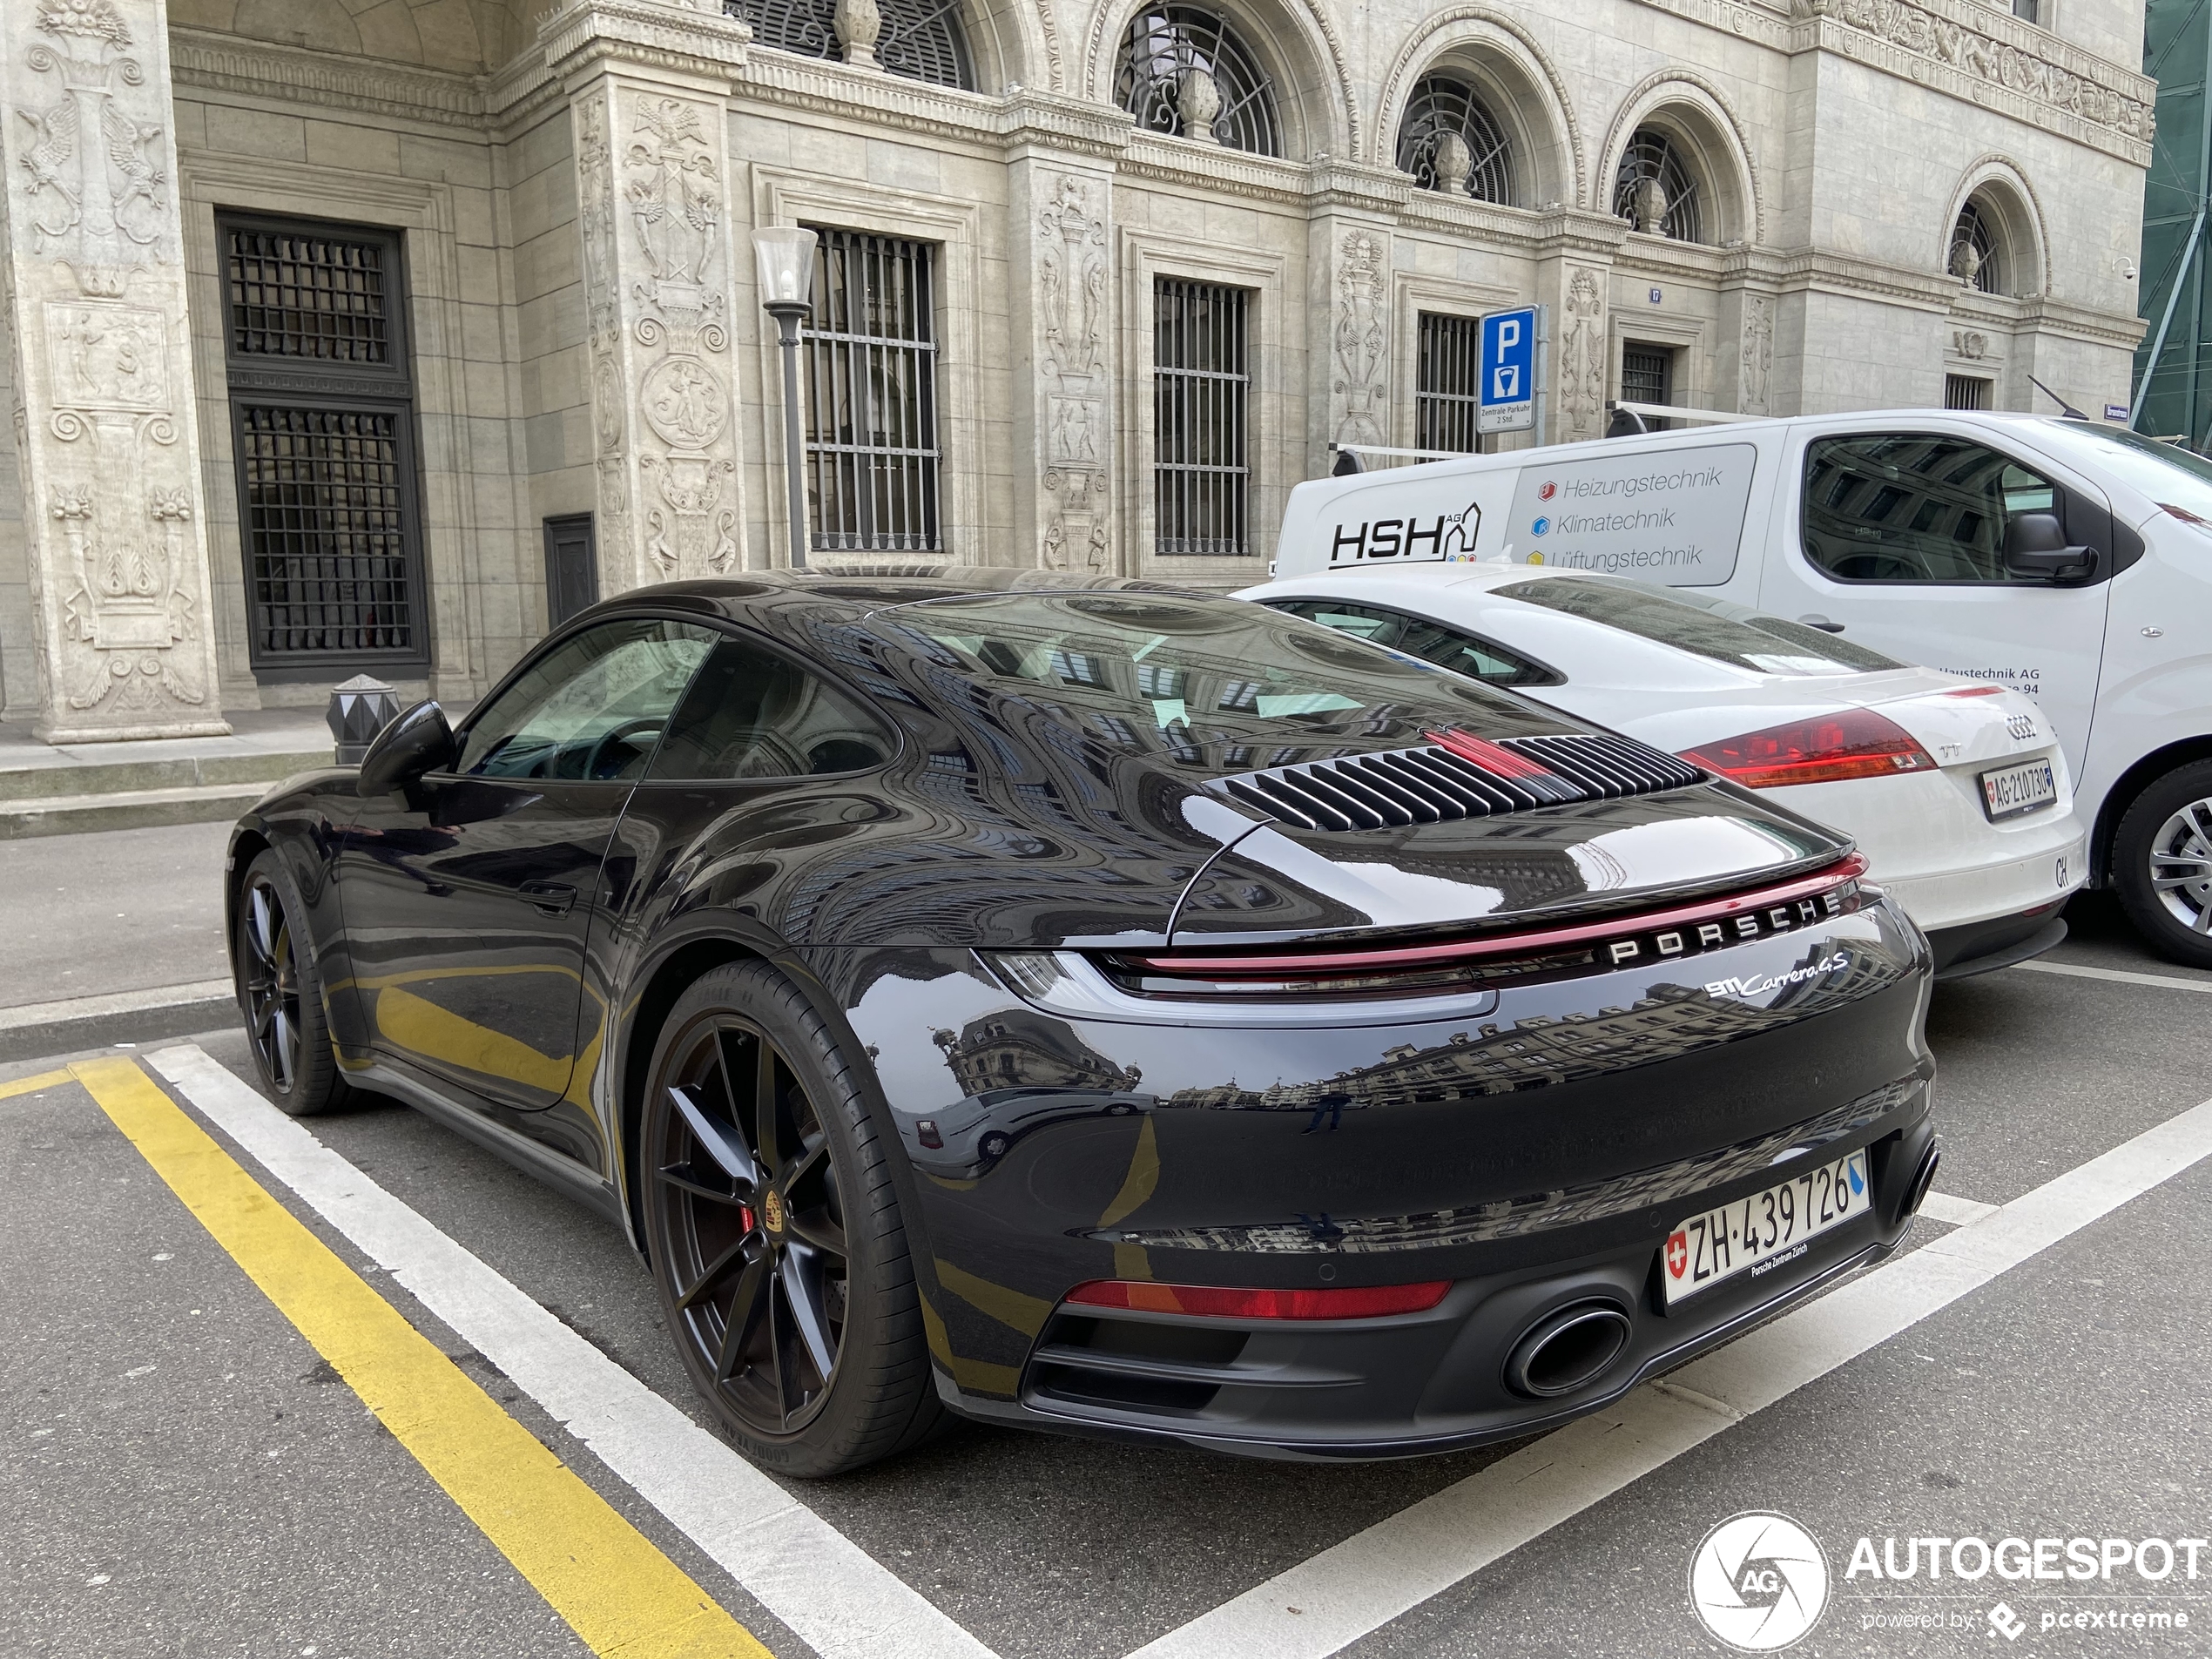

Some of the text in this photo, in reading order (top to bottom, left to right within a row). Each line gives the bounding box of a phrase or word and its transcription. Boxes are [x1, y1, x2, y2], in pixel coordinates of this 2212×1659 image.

[1652, 289, 1660, 301] 17
[1498, 320, 1521, 364] P
[1481, 404, 1531, 416] Zentrale Parkuhr
[1502, 415, 1514, 423] Std.
[1563, 467, 1723, 498] Heizungstechnik
[1556, 508, 1676, 534] Klimatechnik
[1331, 513, 1462, 562] HSH AG
[2020, 669, 2040, 679] AG
[2024, 684, 2039, 694] 94
[1939, 742, 1961, 758] TT
[2055, 855, 2069, 888] CH
[1609, 892, 1841, 965] PORSCHE
[1703, 952, 1849, 998] 911 Carrera 4S
[1751, 1243, 1808, 1278] Porsche Zentrum Zürich
